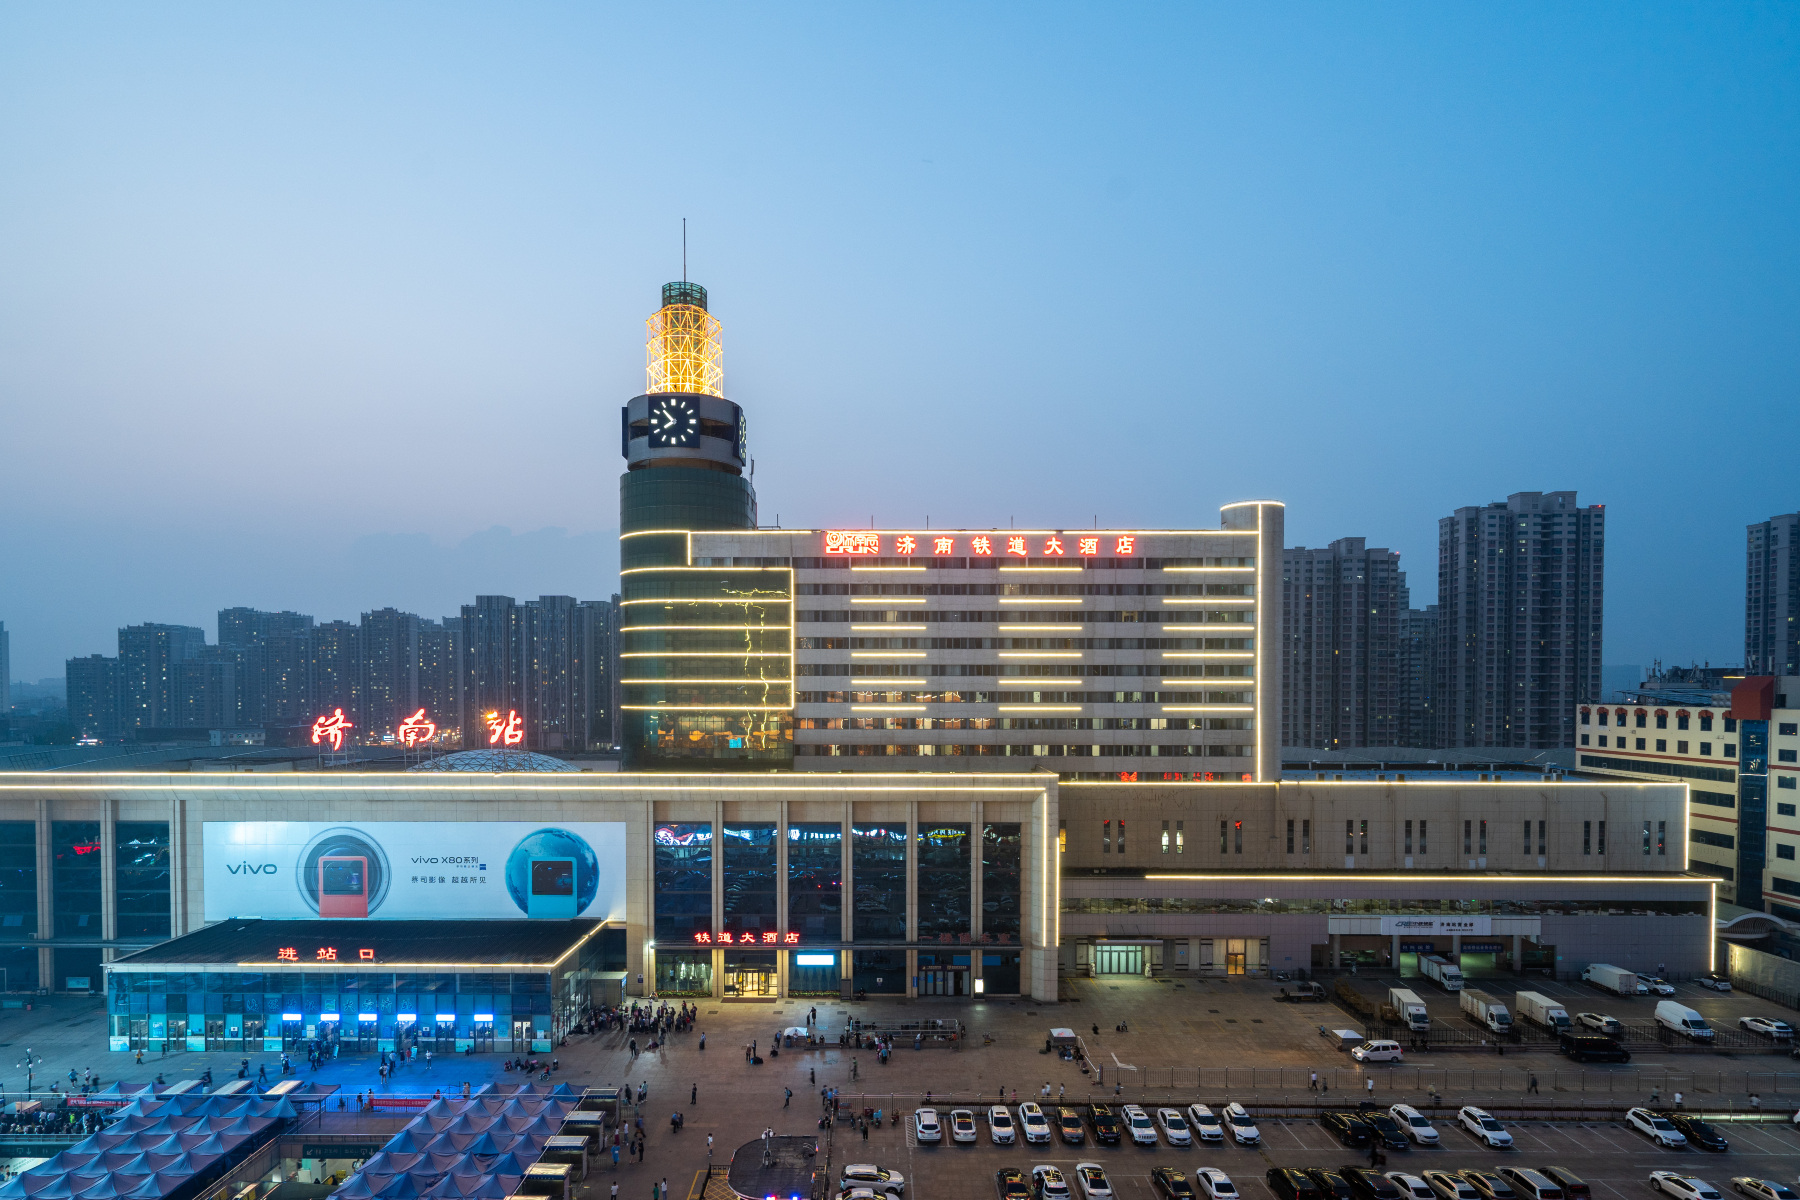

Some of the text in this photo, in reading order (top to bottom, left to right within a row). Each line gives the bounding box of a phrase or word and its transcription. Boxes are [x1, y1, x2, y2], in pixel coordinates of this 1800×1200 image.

[896, 535, 1135, 556] 济南铁道大酒店
[311, 708, 524, 751] 济南站
[411, 855, 479, 864] vivo X80系列
[226, 861, 278, 875] vivo
[451, 875, 487, 884] 超越所见
[694, 932, 800, 943] 铁道大酒店
[277, 946, 375, 961] 进站口
